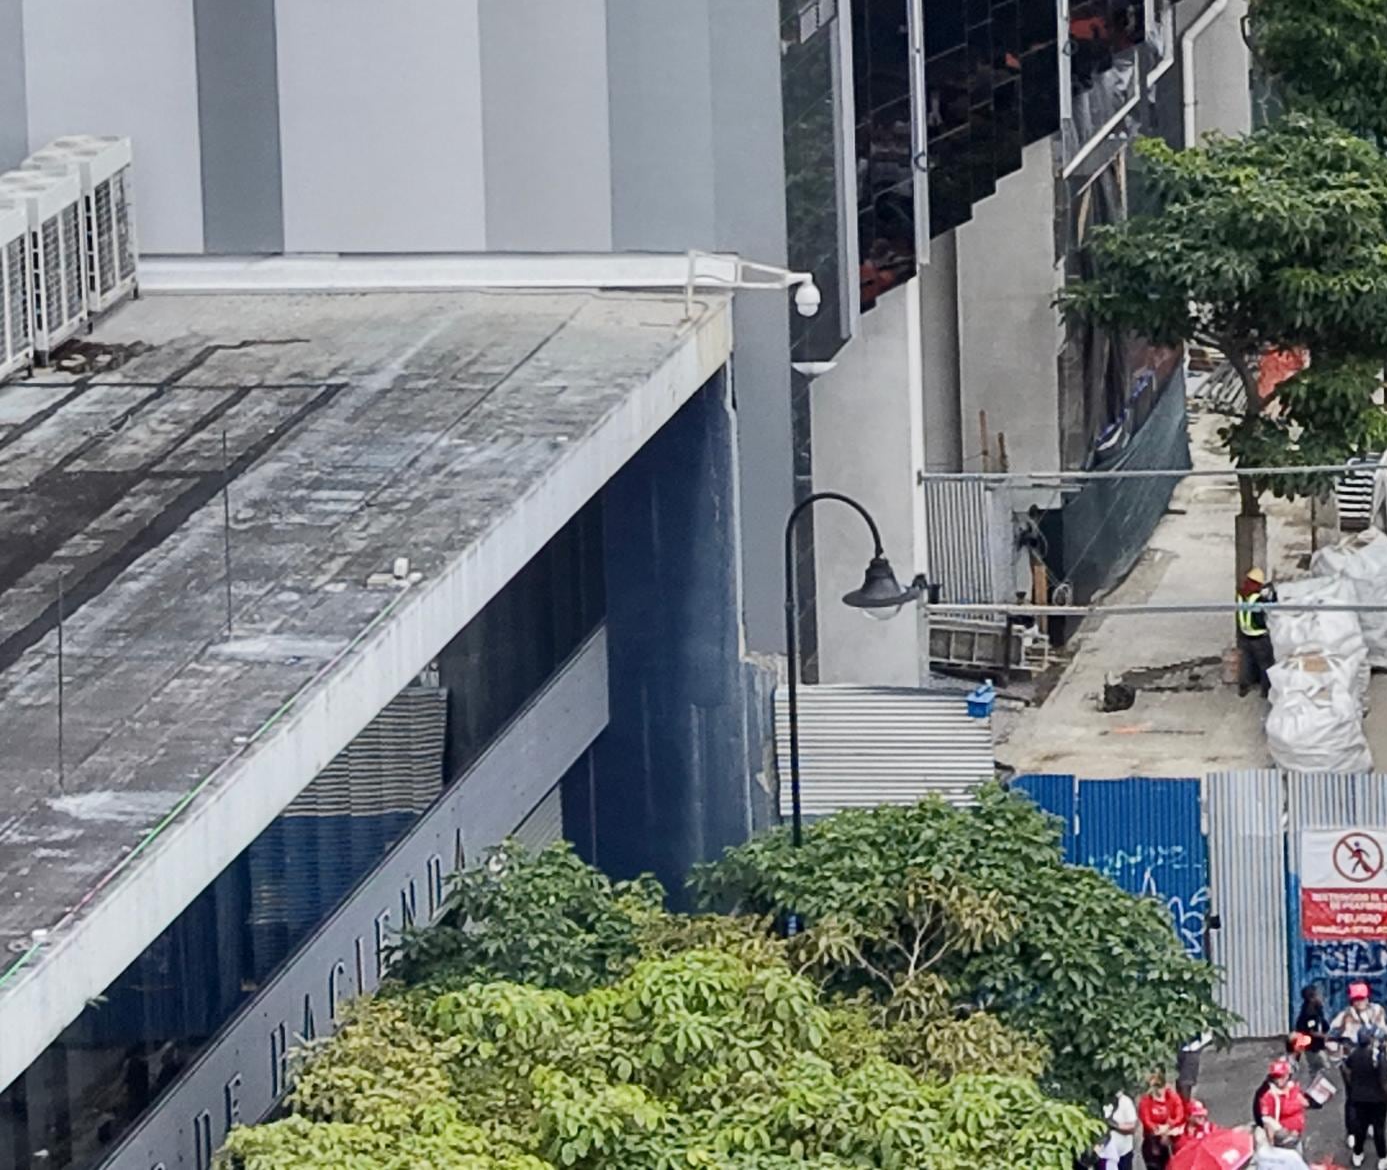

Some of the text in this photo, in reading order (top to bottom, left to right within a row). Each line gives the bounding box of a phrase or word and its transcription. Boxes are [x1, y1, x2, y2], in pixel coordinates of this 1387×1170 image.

[193, 827, 467, 1170] DE HACIENDA
[1335, 913, 1382, 924] PELIGRO
